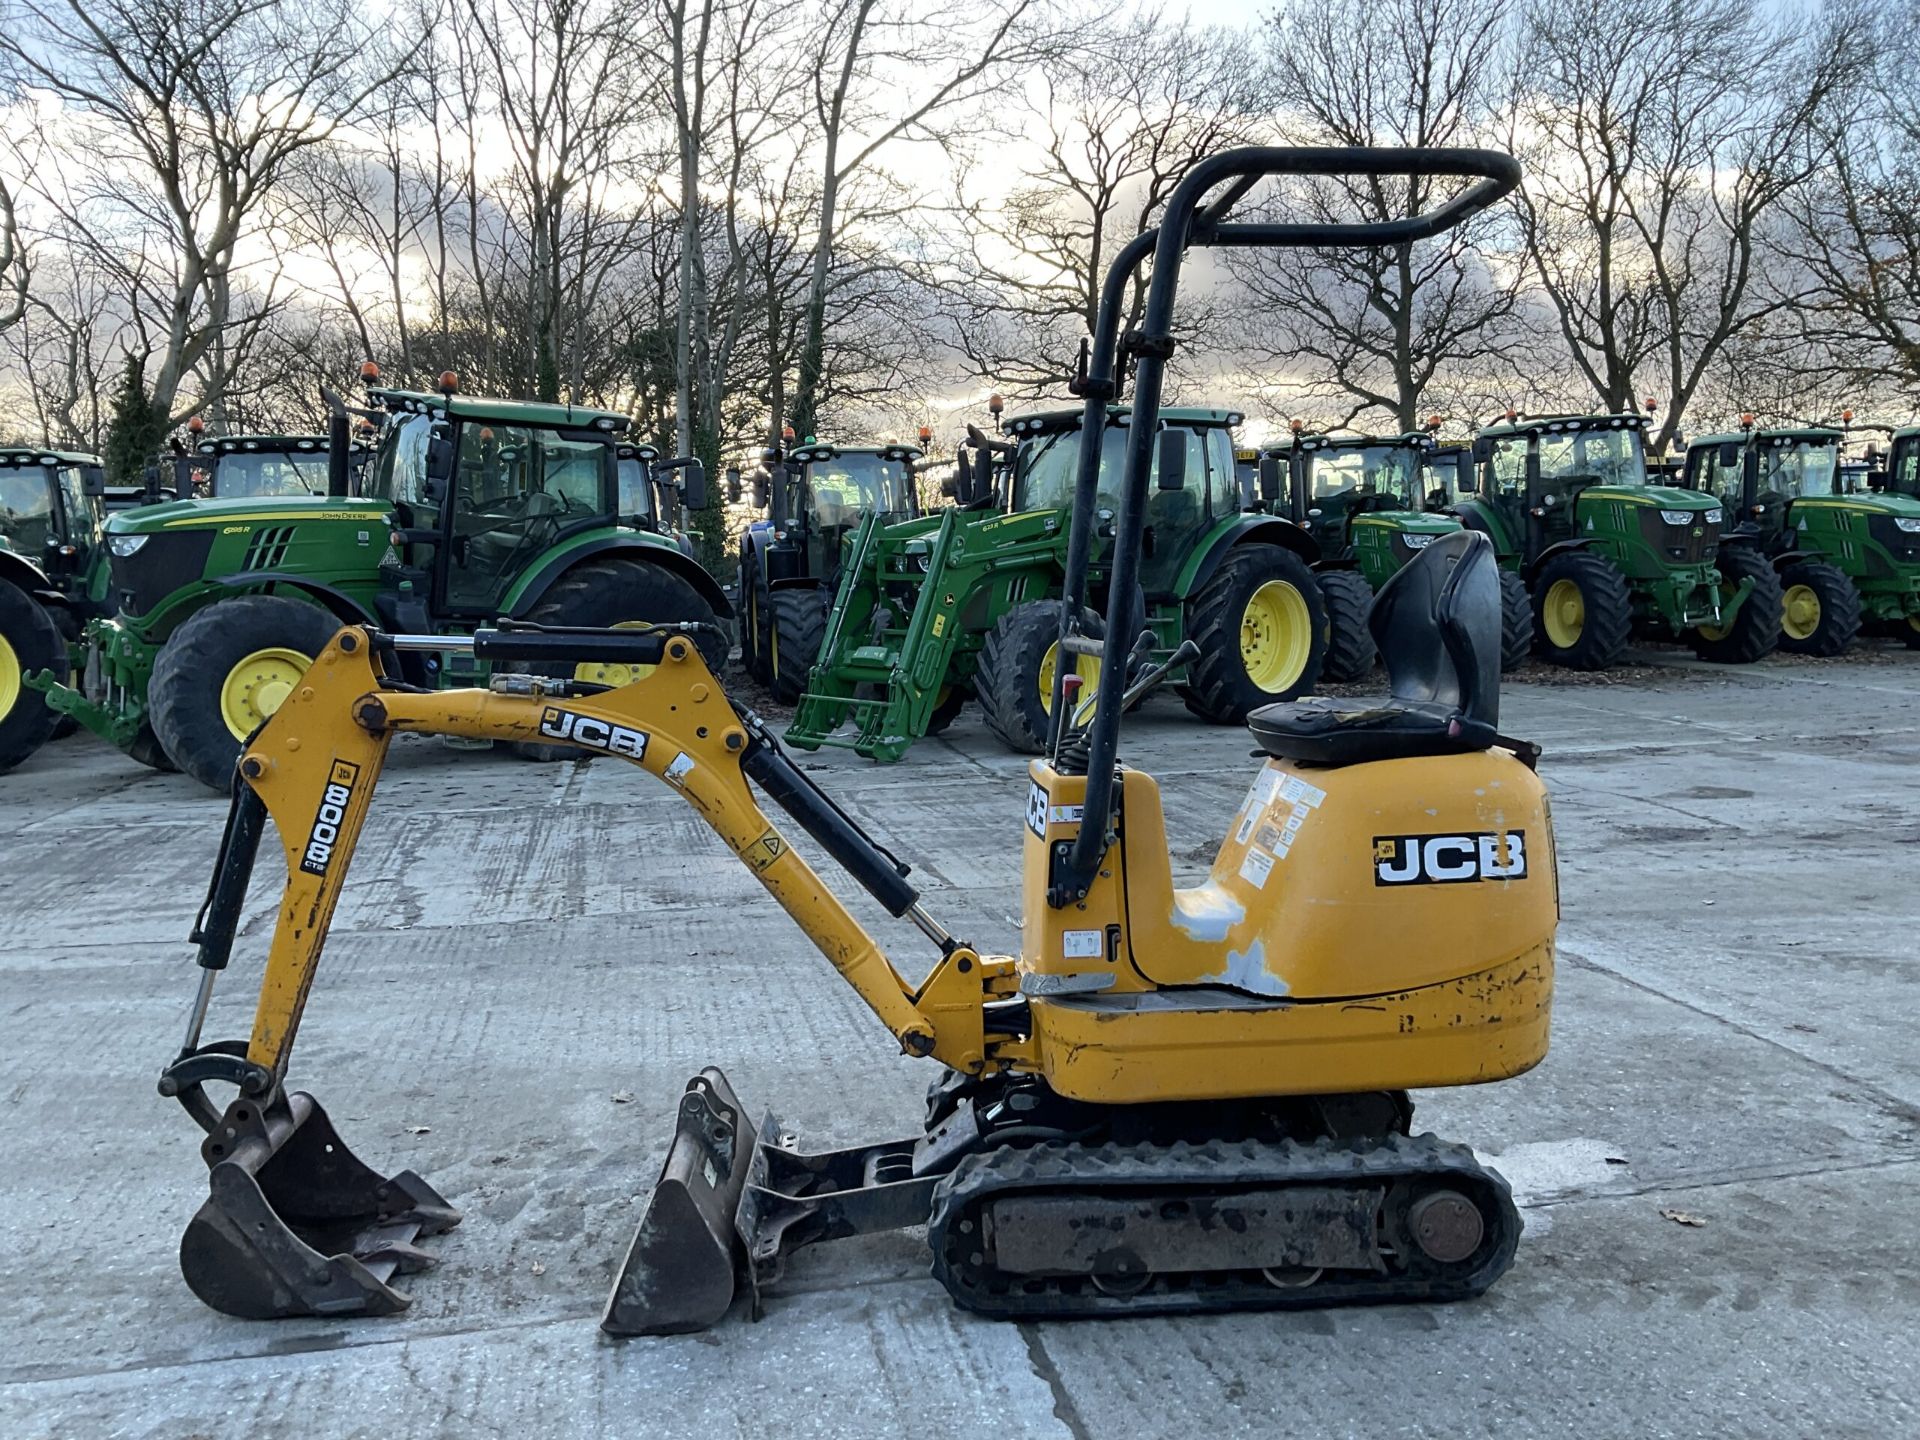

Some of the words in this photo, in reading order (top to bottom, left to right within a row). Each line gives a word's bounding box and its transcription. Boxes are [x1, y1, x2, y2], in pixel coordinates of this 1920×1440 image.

[341, 512, 368, 520] DEERE
[542, 713, 646, 759] JCB
[307, 784, 350, 864] 8008
[1378, 834, 1525, 882] JCB
